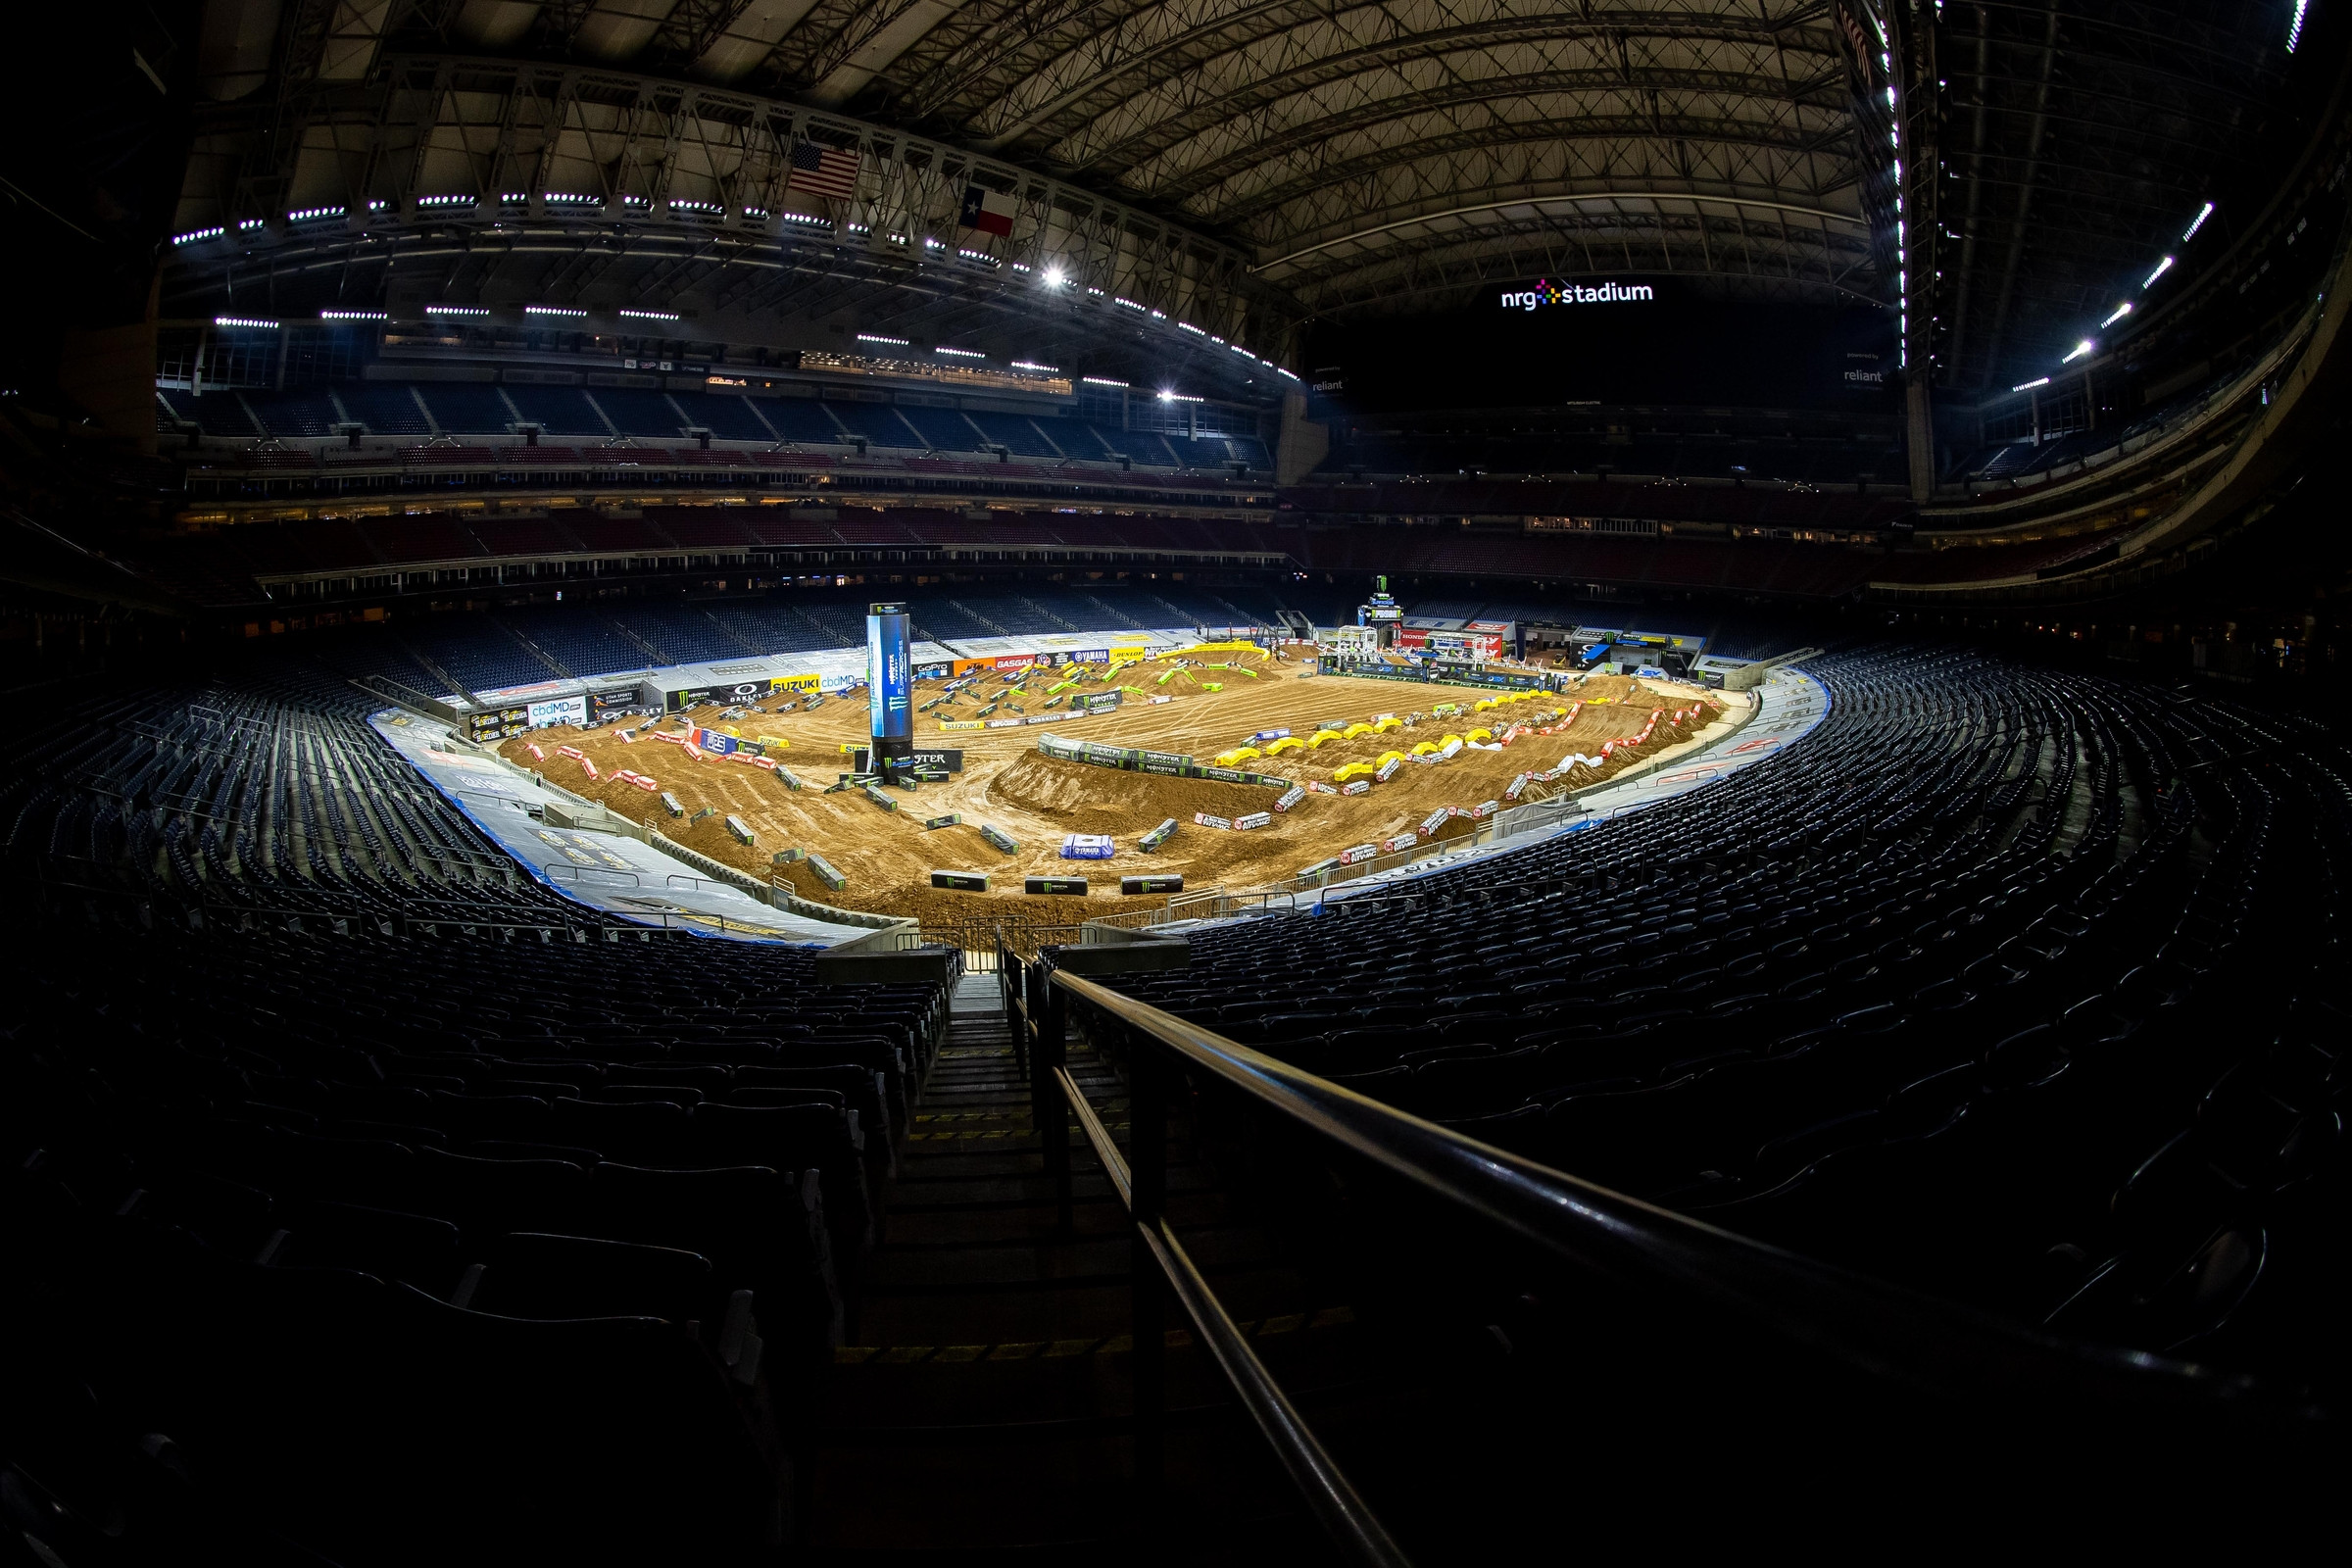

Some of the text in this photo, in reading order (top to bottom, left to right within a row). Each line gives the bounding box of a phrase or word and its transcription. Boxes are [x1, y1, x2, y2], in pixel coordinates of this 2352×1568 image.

[1501, 282, 1652, 311] nrg stadium
[1844, 369, 1883, 382] reliant
[1313, 380, 1344, 391] reliant
[1083, 651, 1107, 660] YAMAHA
[918, 663, 948, 673] GoPro
[997, 659, 1033, 668] GASGAS
[773, 678, 820, 692] SUZUKI
[822, 674, 856, 687] cbdMD
[1090, 693, 1117, 703] MONSTER
[533, 702, 570, 716] cbdMD
[760, 737, 781, 747] SUZUKI
[1093, 746, 1121, 755] MONSTER
[1091, 756, 1117, 764] MONSTER
[1147, 753, 1179, 762] MONSTER
[1146, 765, 1176, 773] MONSTER
[1209, 770, 1238, 779] MONSTER
[1263, 778, 1284, 786] MONSTER
